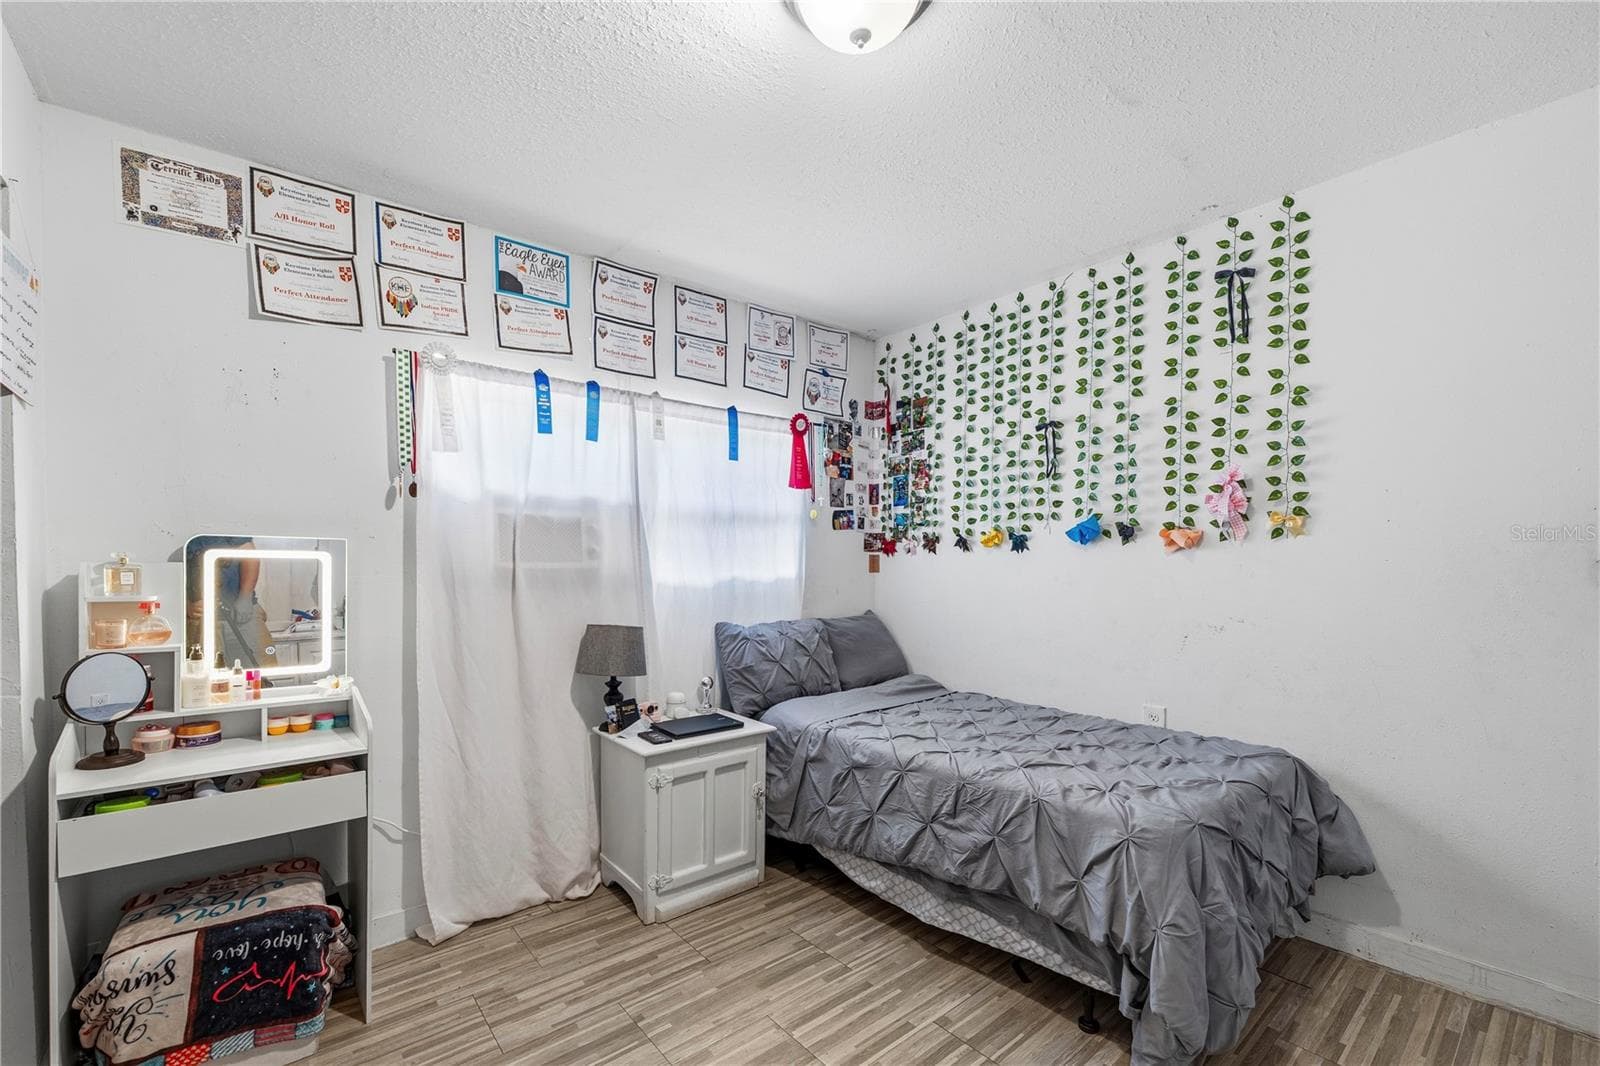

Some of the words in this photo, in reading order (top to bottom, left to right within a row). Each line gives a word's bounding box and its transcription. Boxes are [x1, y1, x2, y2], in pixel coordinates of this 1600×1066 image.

[504, 242, 539, 265] Eagle
[540, 253, 567, 271] Eyes
[529, 263, 566, 283] AWARD
[173, 880, 284, 925] you
[211, 941, 251, 962] love
[259, 930, 304, 952] hope
